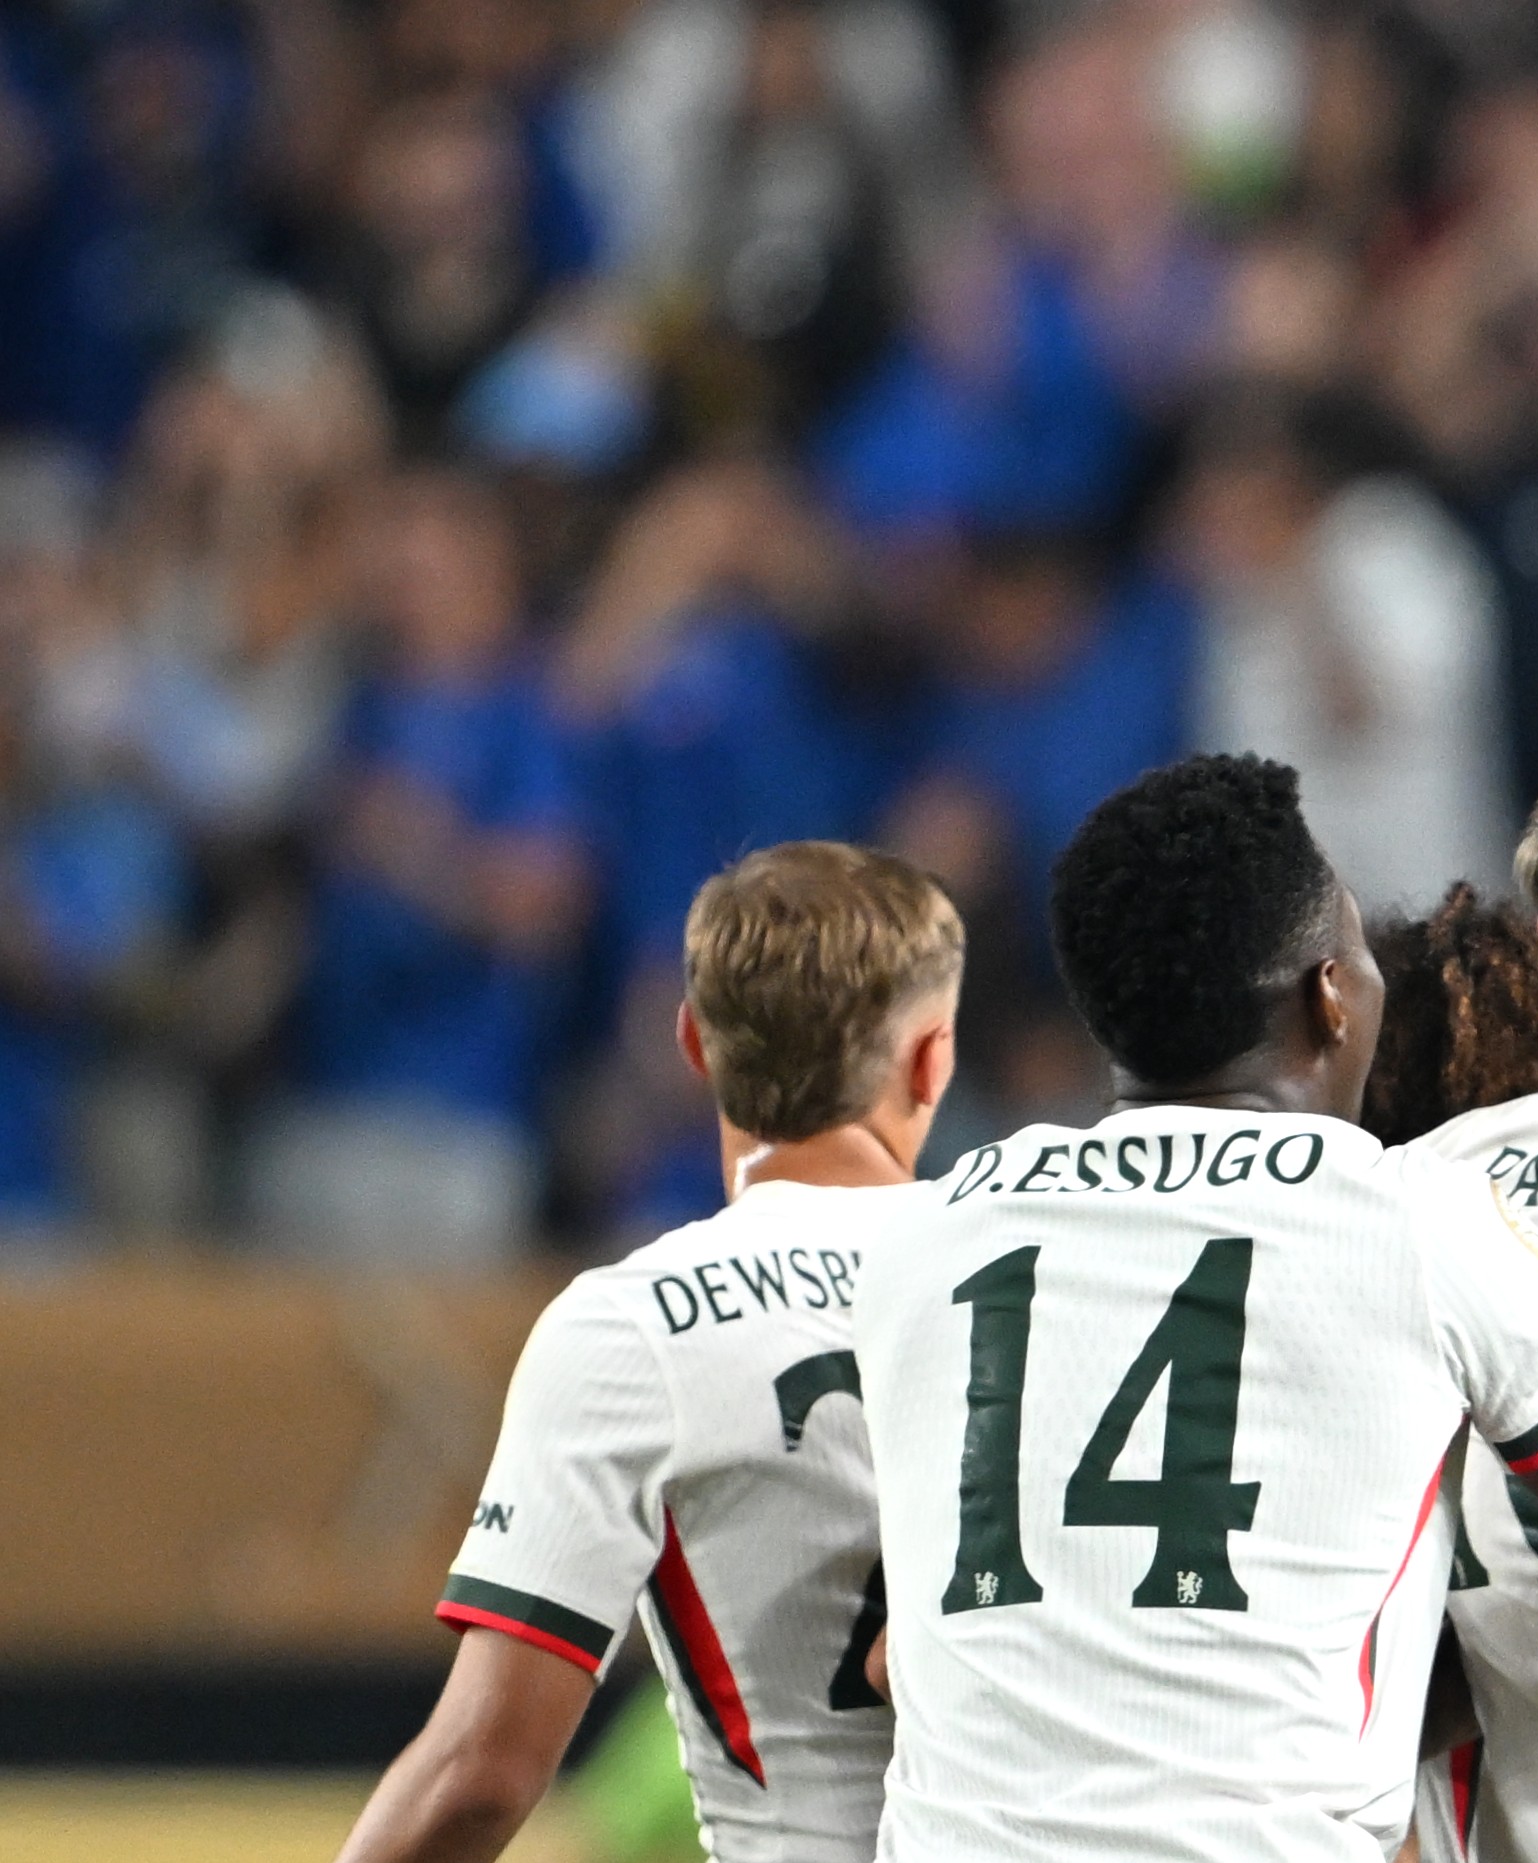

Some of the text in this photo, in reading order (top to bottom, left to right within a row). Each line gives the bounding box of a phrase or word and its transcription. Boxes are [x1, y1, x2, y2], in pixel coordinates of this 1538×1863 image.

[949, 1128, 1324, 1204] D.ESSUGO
[652, 1247, 862, 1334] DEWSB
[941, 1236, 1262, 1616] 14
